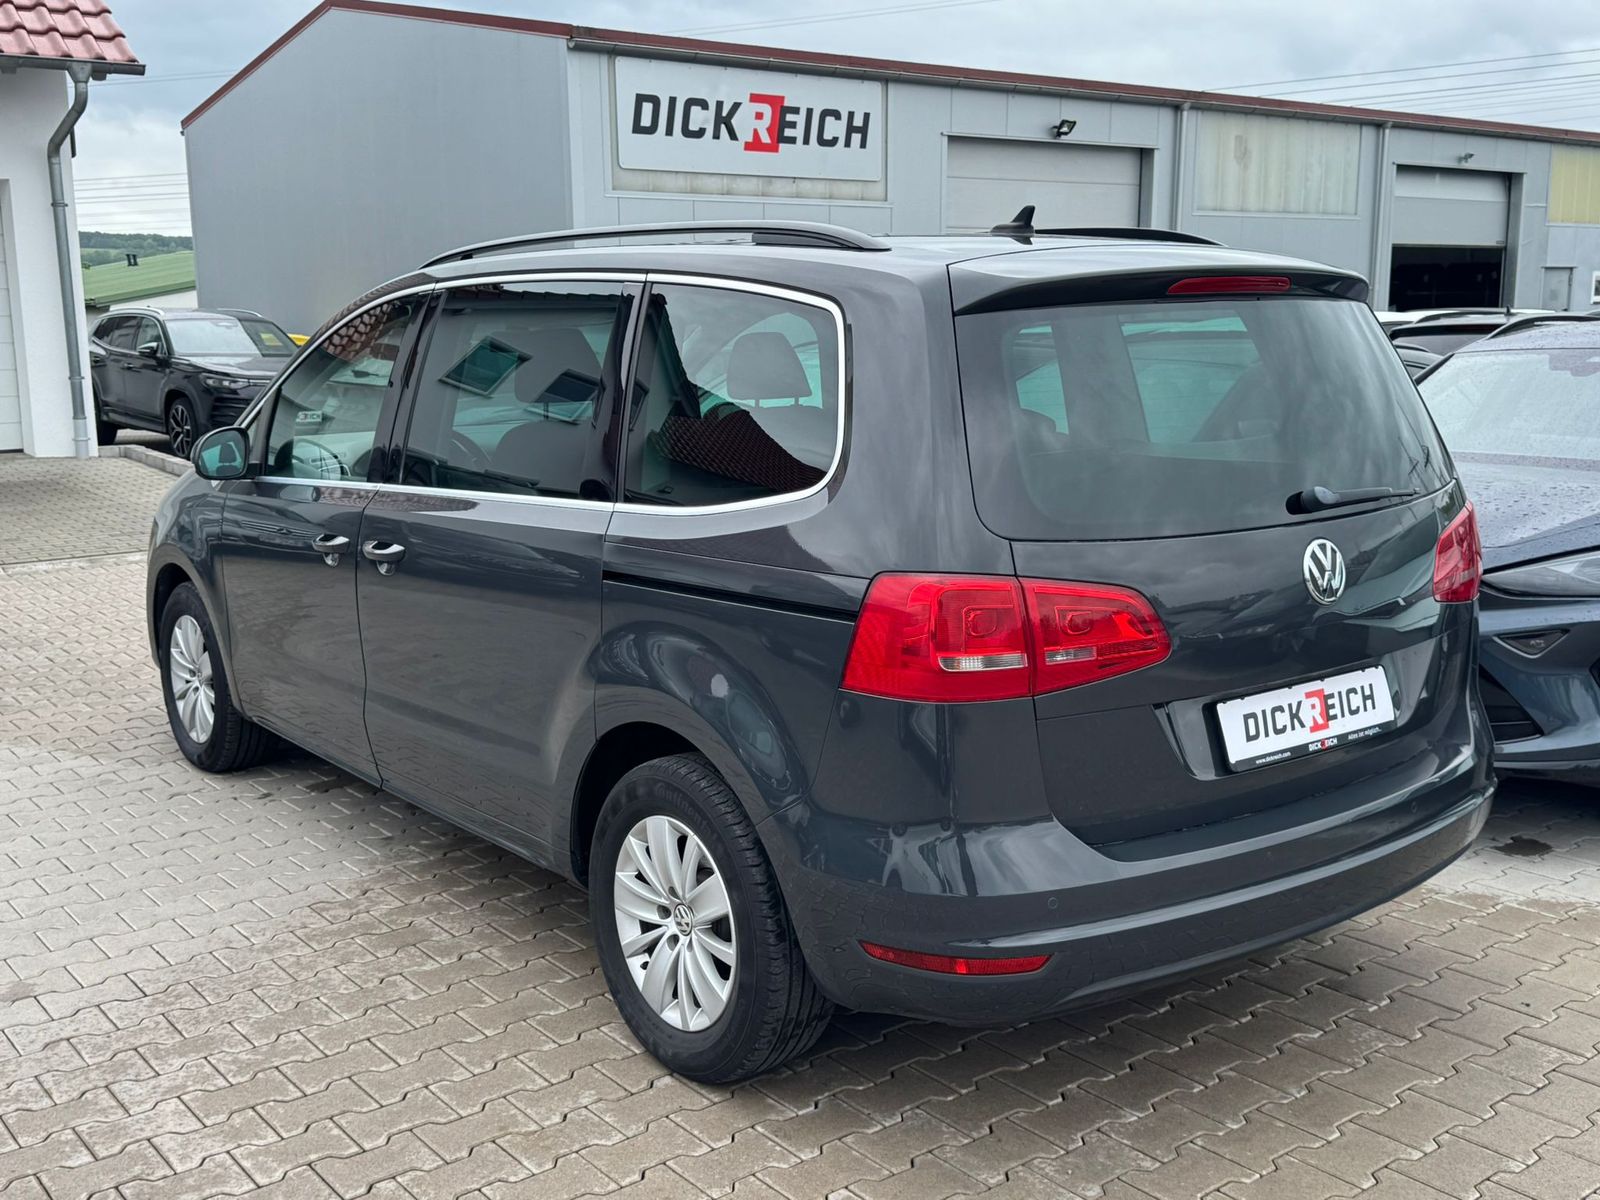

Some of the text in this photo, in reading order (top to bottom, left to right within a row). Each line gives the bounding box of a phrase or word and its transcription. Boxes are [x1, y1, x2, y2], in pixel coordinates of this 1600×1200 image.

[632, 93, 870, 151] DICKREICH
[1243, 683, 1376, 742] DICKREICH
[1255, 751, 1291, 764] www.dickreich.com
[1309, 738, 1337, 750] DICKREICH
